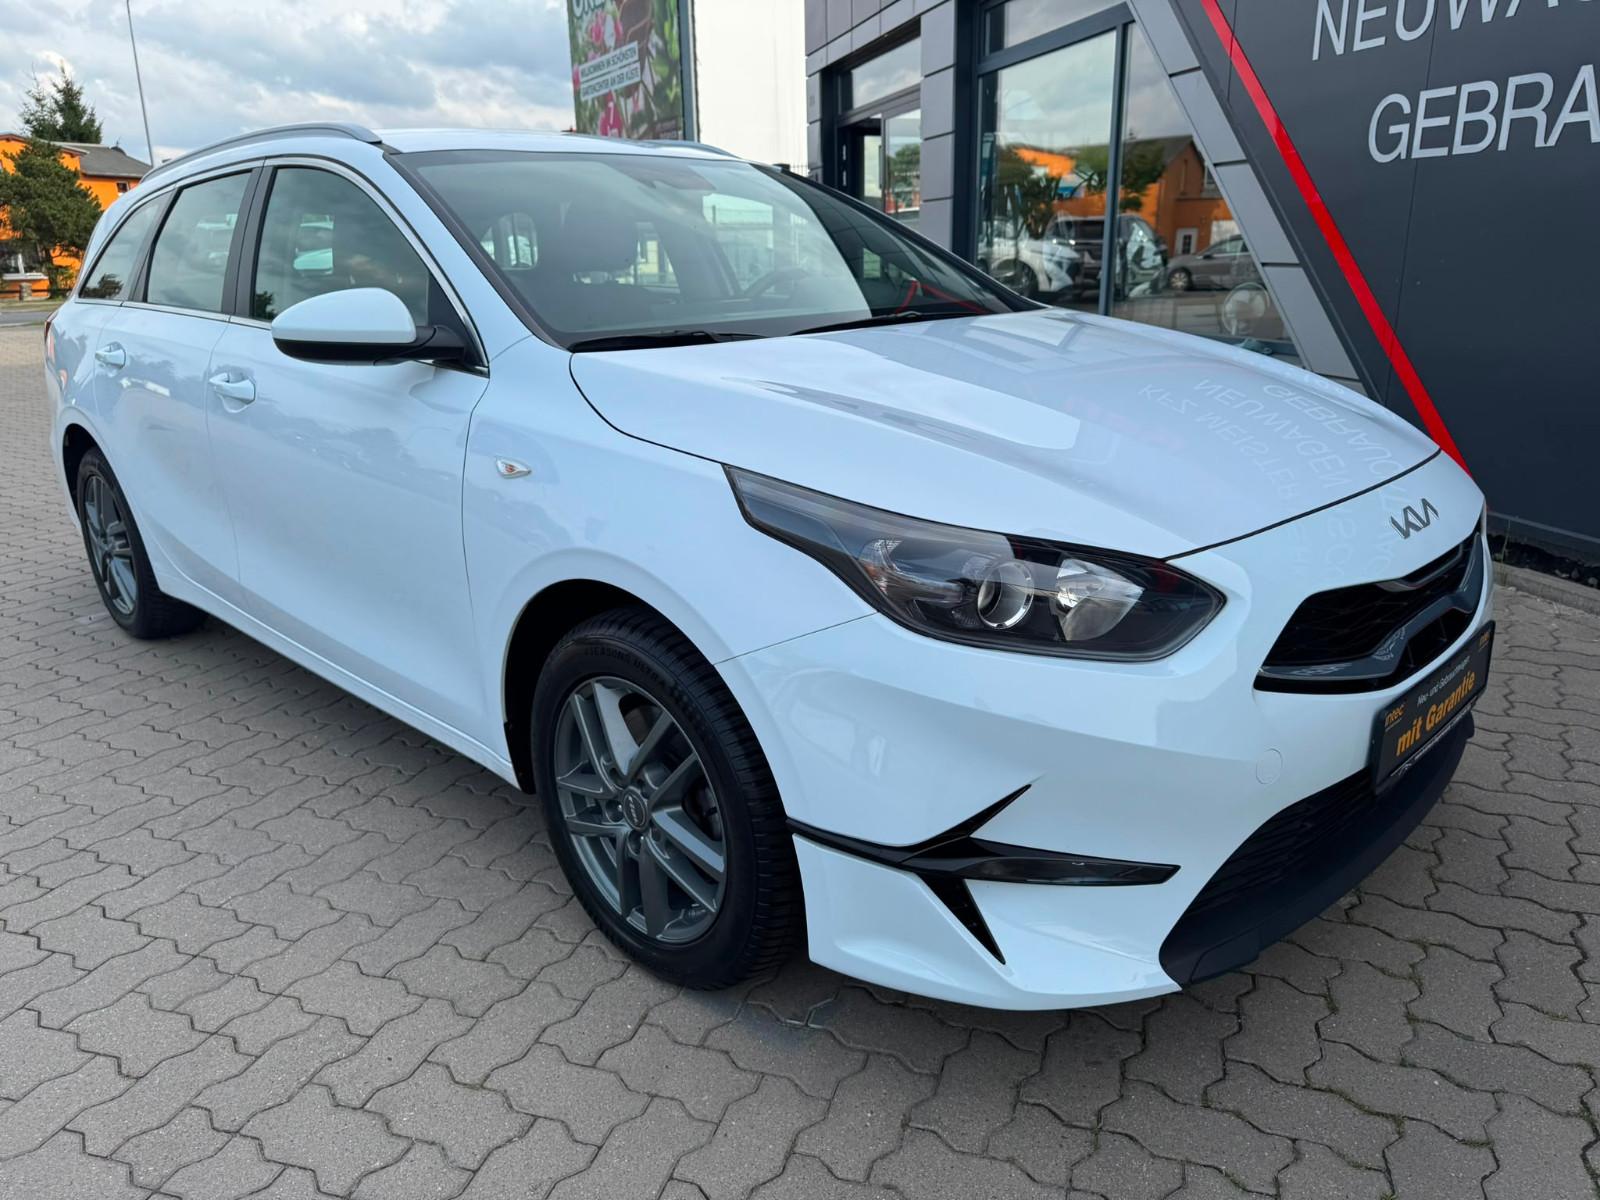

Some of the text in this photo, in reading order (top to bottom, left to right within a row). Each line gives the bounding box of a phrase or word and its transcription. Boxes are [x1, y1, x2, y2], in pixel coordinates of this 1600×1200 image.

[1368, 64, 1600, 163] GEBRA
[1396, 715, 1424, 757] mit
[1425, 670, 1476, 732] Garantie
